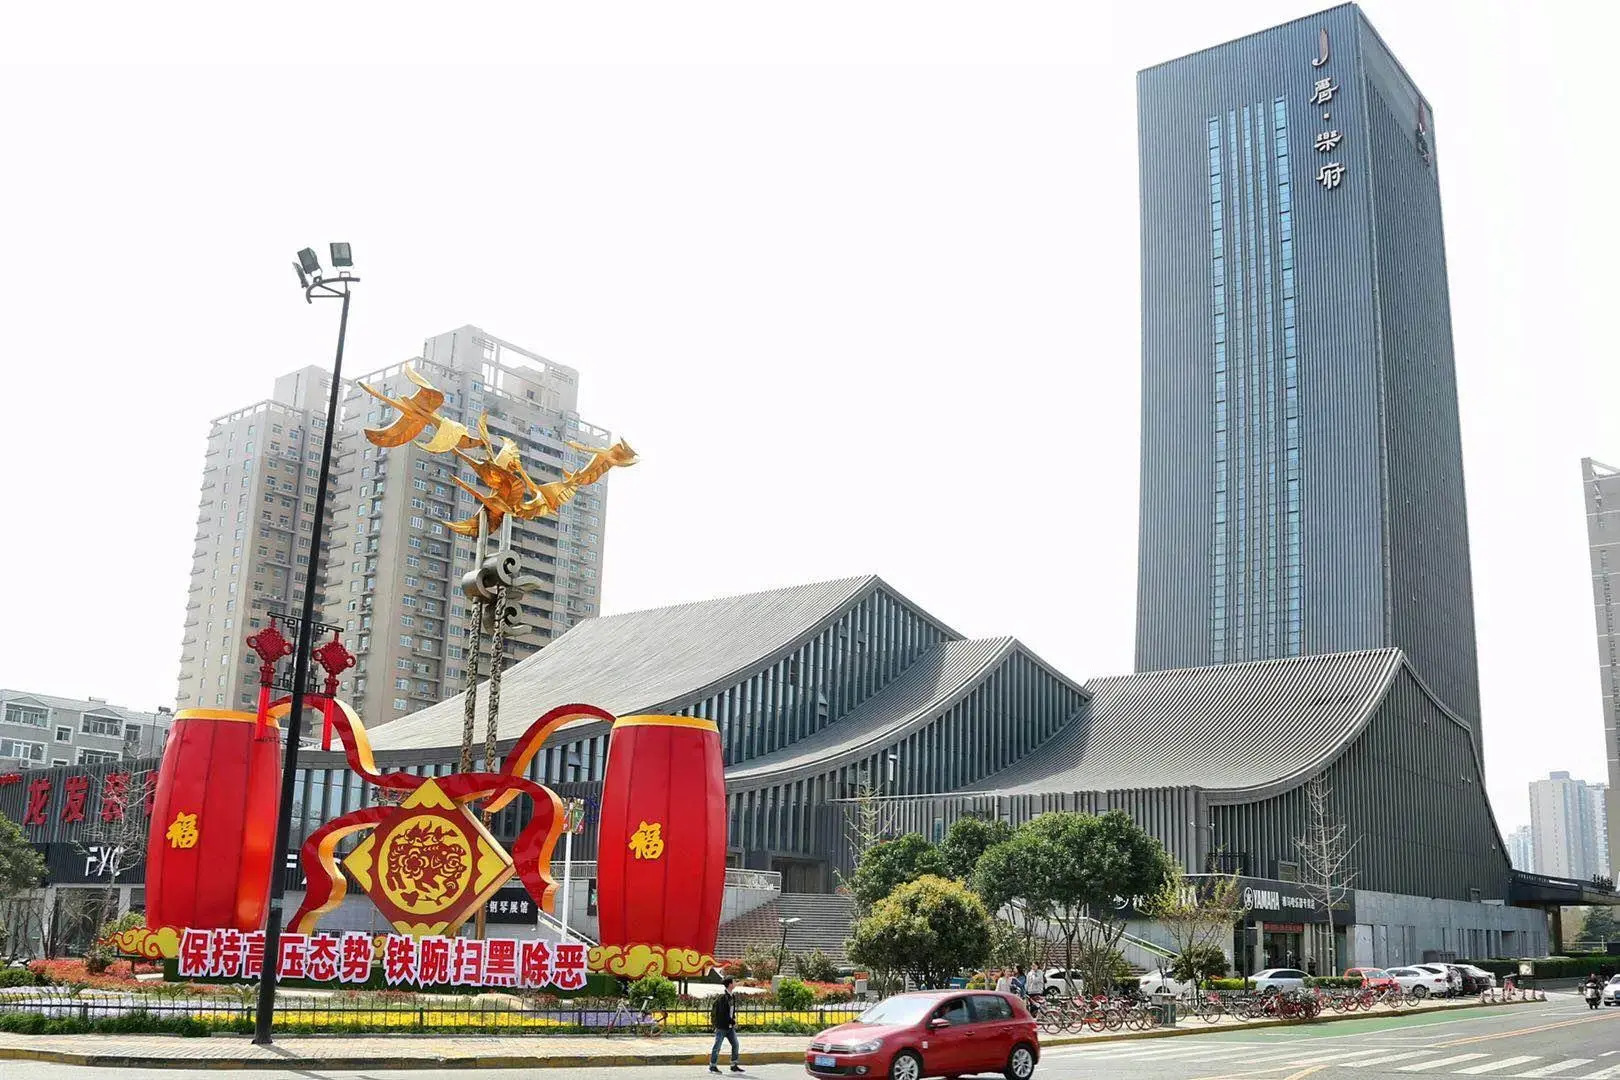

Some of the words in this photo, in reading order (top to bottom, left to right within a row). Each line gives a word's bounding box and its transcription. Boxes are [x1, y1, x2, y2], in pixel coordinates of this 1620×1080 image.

[165, 811, 199, 849] 福
[628, 820, 665, 860] 福
[485, 900, 529, 914] 钢琴展馆
[1253, 889, 1280, 910] YAMAHA
[180, 929, 373, 981] 保持高压态势
[385, 935, 586, 989] 铁腕扫黑除恶
